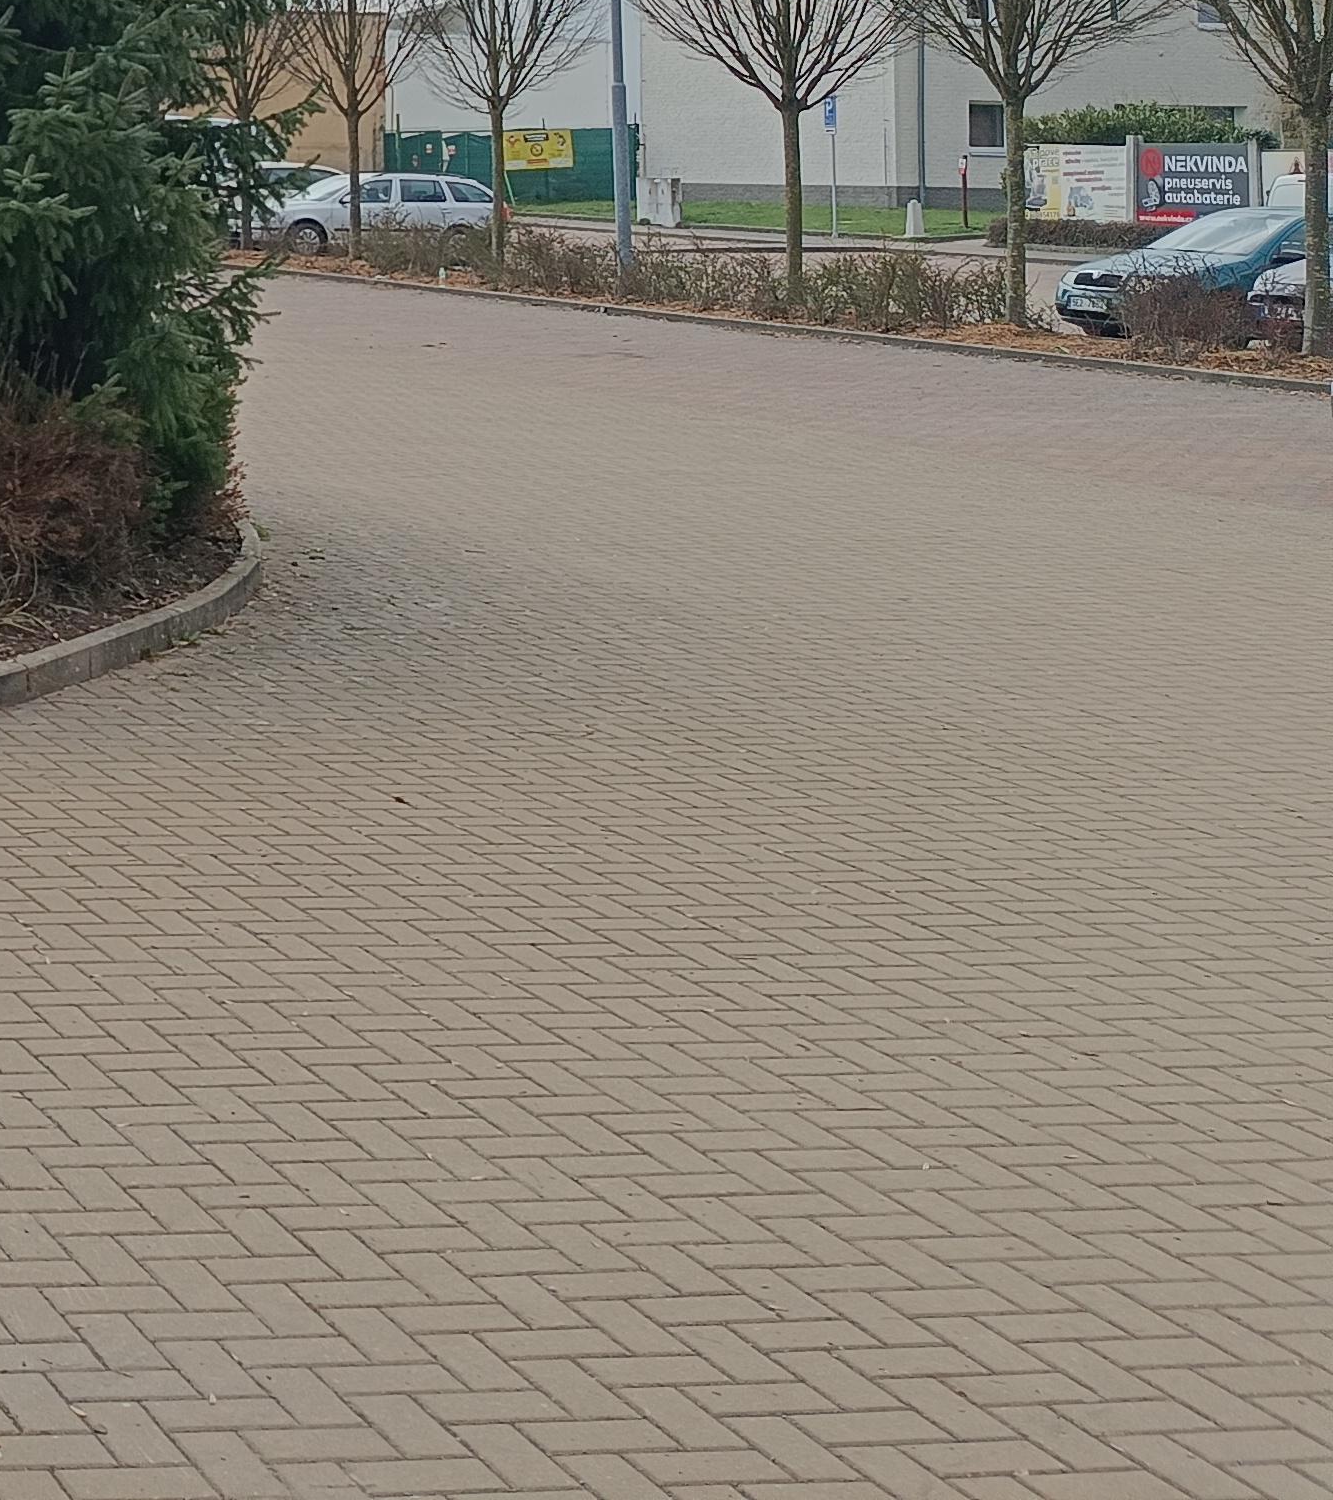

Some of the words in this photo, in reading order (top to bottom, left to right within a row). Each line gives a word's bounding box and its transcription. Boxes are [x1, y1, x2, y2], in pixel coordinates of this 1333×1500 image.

[1164, 155, 1248, 173] NEKVINDA
[1164, 174, 1233, 191] pneuservis
[1164, 191, 1241, 206] autobaterie
